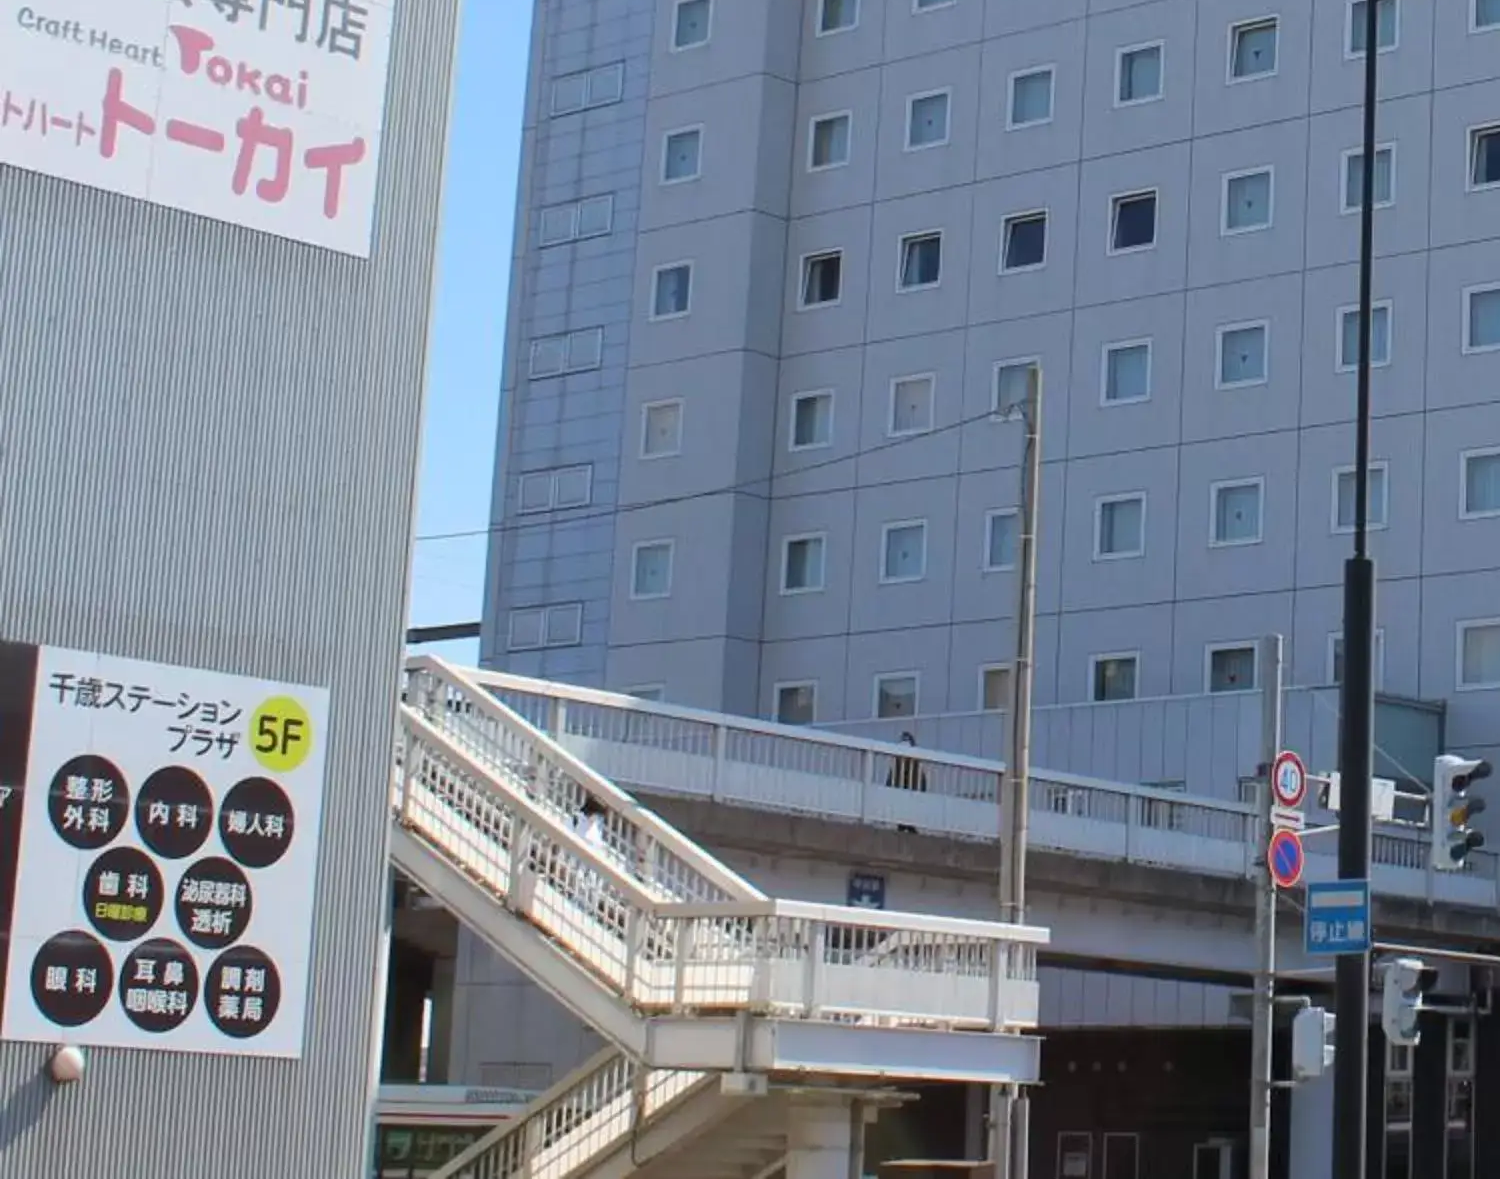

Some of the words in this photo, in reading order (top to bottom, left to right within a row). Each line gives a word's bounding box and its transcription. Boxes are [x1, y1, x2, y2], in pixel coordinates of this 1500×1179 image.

[18, 6, 84, 44] Craft
[90, 28, 163, 68] Heart
[169, 25, 309, 109] Tokai
[49, 672, 243, 726] 千歳ステーション
[167, 723, 241, 760] プラザ
[255, 715, 305, 755] 5F
[65, 775, 113, 802] 整形
[1280, 768, 1298, 794] 40
[63, 805, 109, 832] 外科
[148, 800, 198, 829] 内科
[227, 809, 284, 837] 婦人科
[98, 871, 149, 900] 歯科
[181, 878, 246, 907] 泌尿器科
[190, 908, 233, 935] 透析
[45, 965, 97, 993] 眼科
